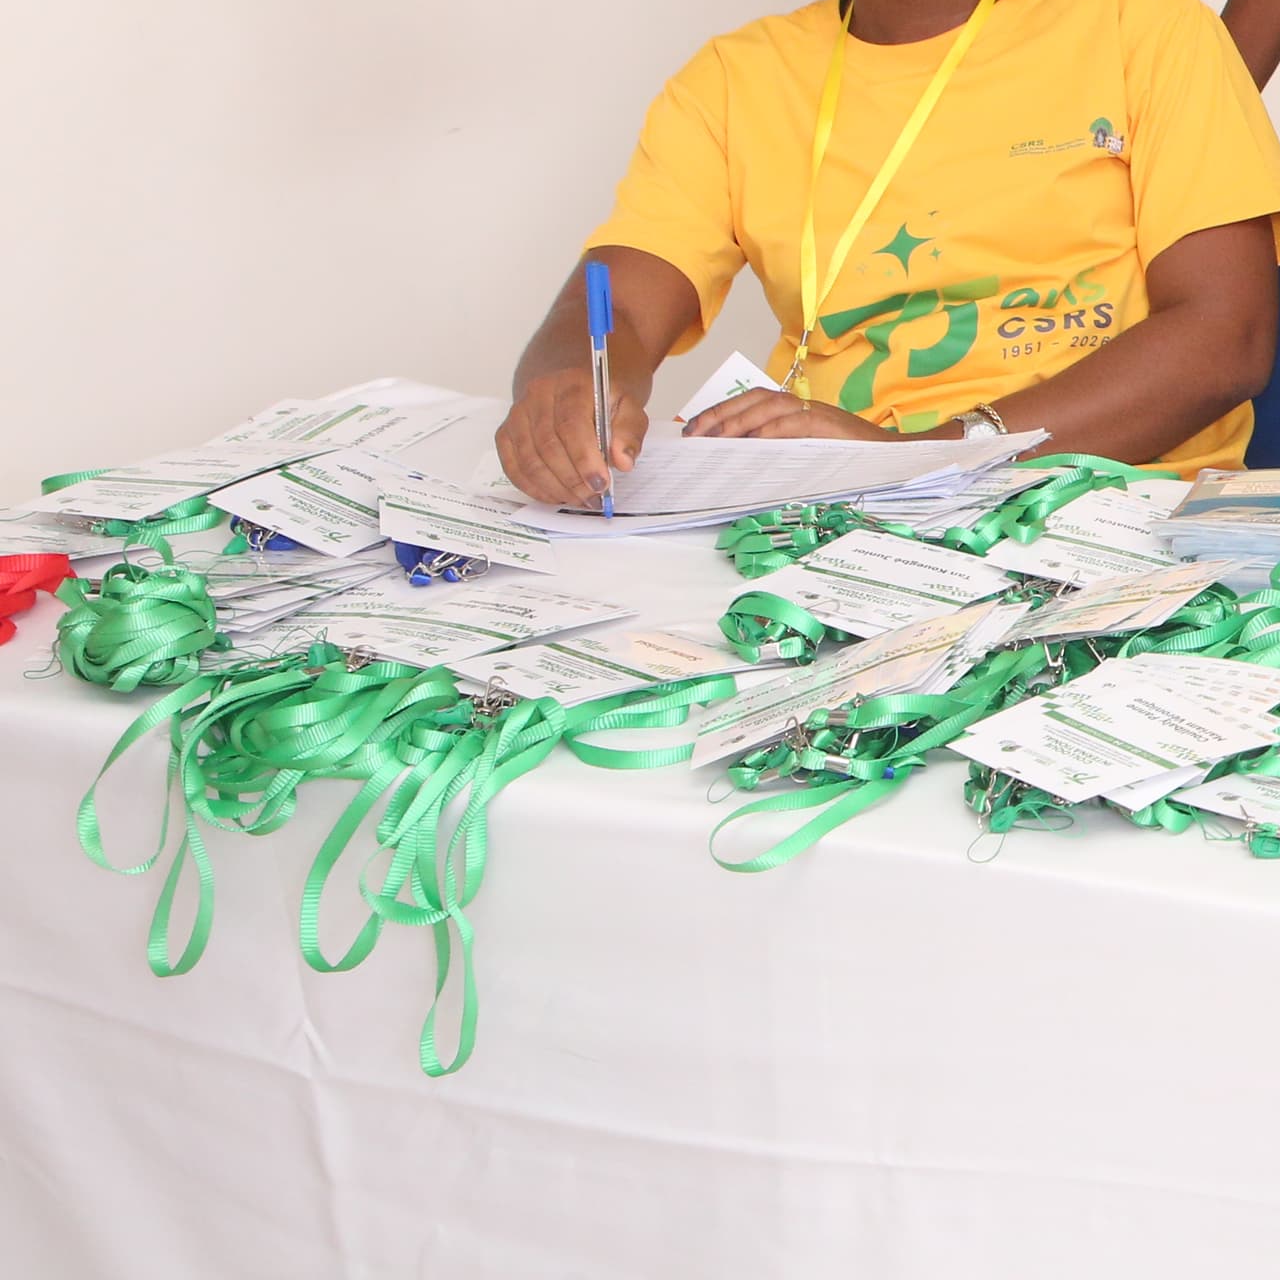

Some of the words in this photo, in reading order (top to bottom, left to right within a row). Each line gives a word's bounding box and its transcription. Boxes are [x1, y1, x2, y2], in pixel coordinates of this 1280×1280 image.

[1000, 266, 1107, 309] ans
[997, 302, 1113, 339] CSRS
[1003, 342, 1041, 360] 1951
[851, 548, 891, 563] Junior
